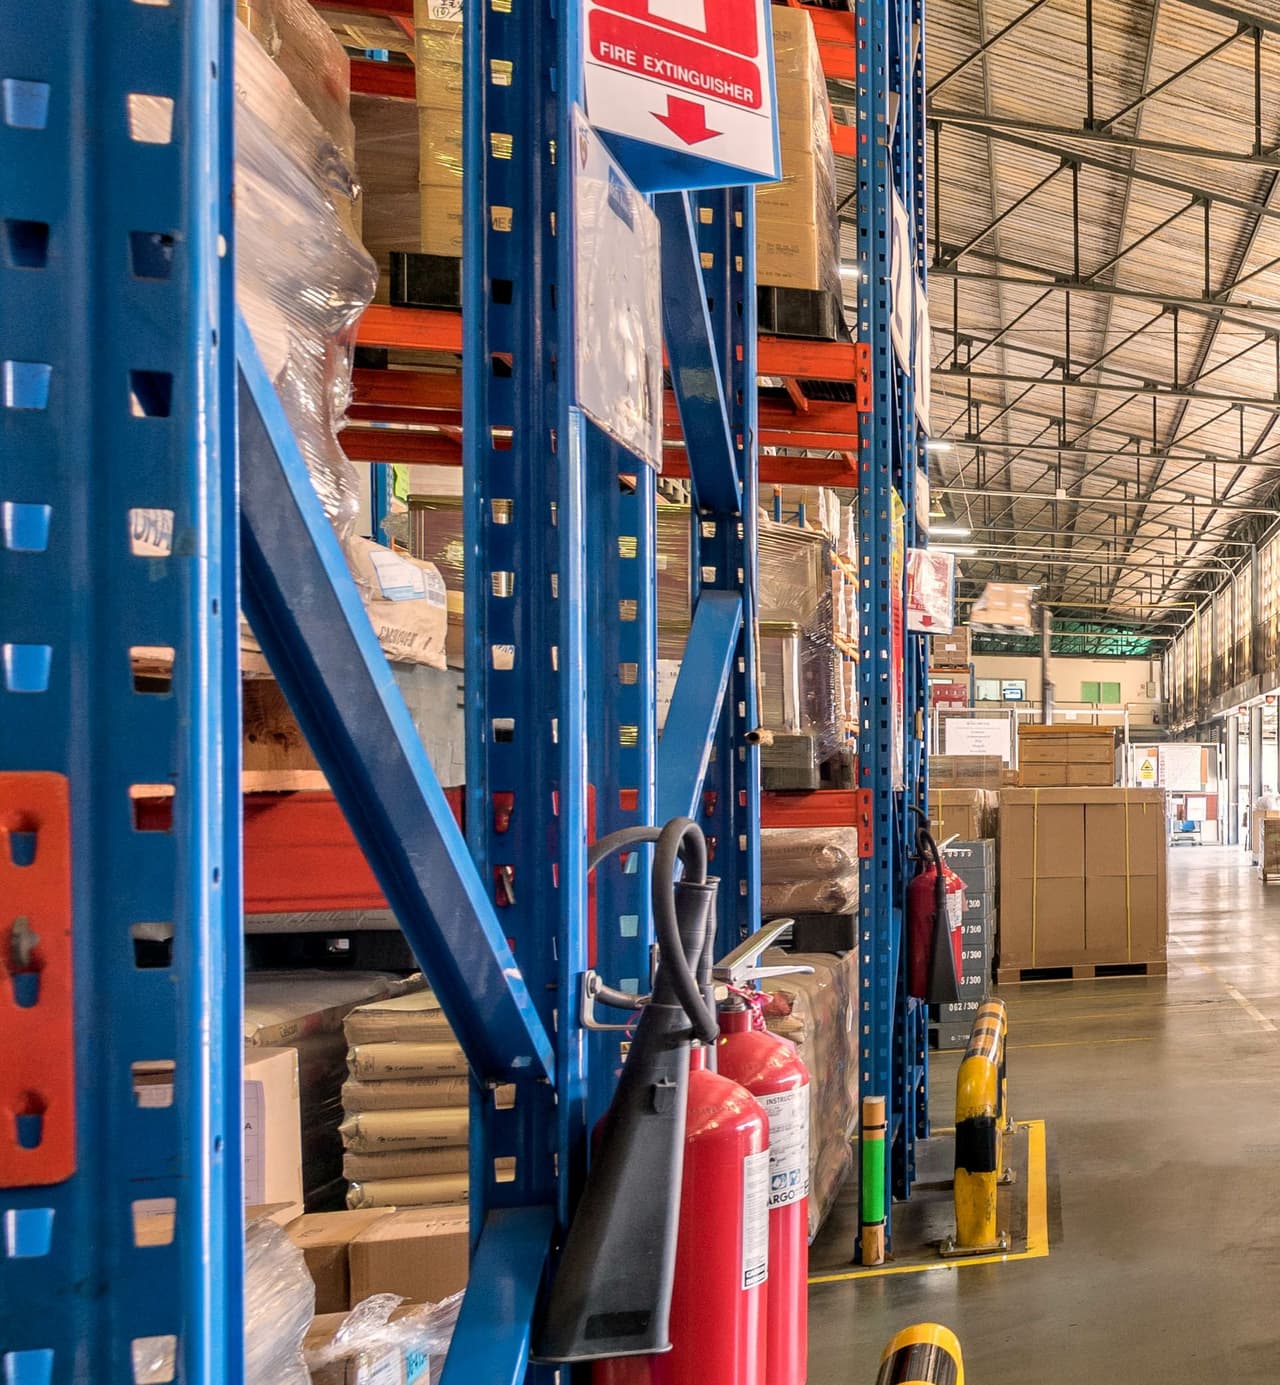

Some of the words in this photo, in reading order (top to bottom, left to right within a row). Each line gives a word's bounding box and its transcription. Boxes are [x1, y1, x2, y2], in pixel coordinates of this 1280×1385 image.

[599, 41, 637, 66] FIRE
[643, 56, 754, 103] EXTINGUISHER
[961, 925, 982, 934] 9/300
[961, 950, 982, 960] 0/300
[961, 976, 981, 985] 5/300
